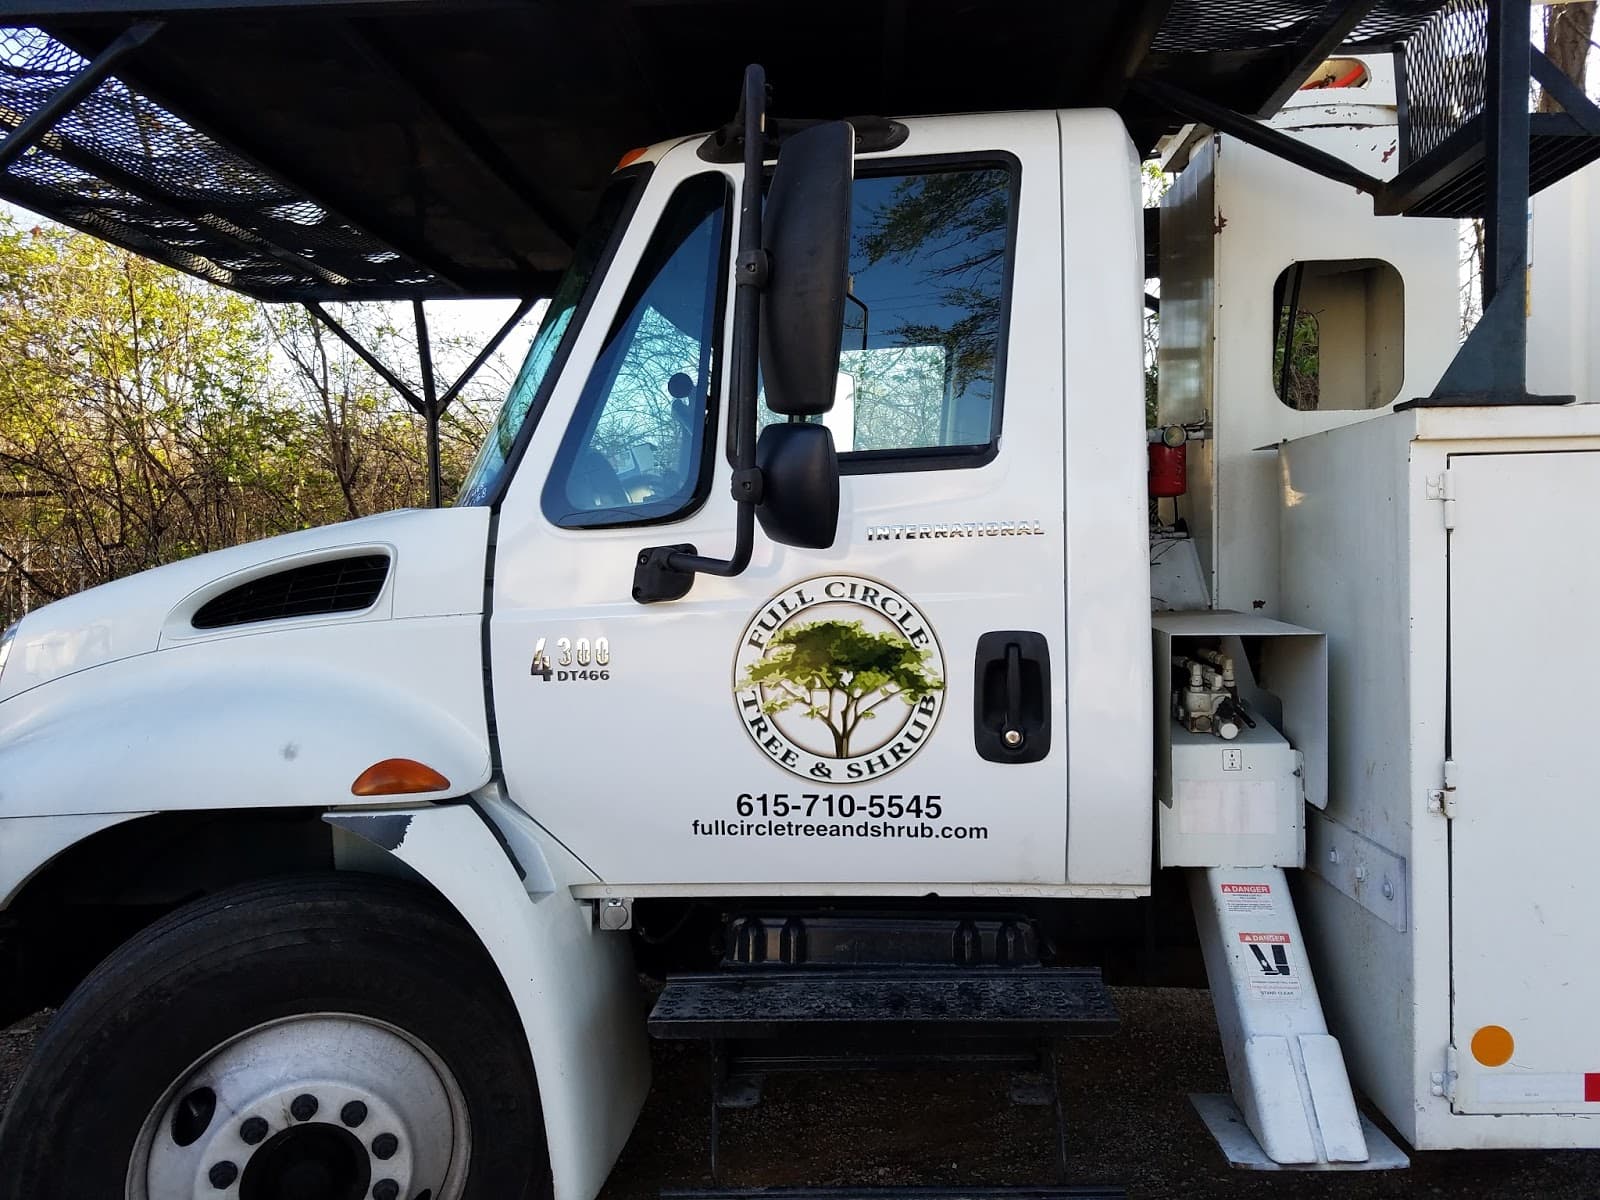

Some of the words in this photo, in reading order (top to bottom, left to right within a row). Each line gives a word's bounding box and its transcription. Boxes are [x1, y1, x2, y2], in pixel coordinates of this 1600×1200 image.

[867, 520, 1045, 541] INTERNATIONAL
[747, 588, 815, 650] FULL
[824, 581, 930, 649] CIRCLE
[530, 636, 611, 682] 4300
[557, 670, 610, 682] DT466
[742, 690, 800, 768] TREE
[809, 761, 833, 780] &
[846, 694, 936, 779] SHRUB
[736, 794, 942, 820] 615-710-5545
[692, 819, 989, 840] fullcircletreeandshrub.com
[1232, 885, 1269, 893] DANGER
